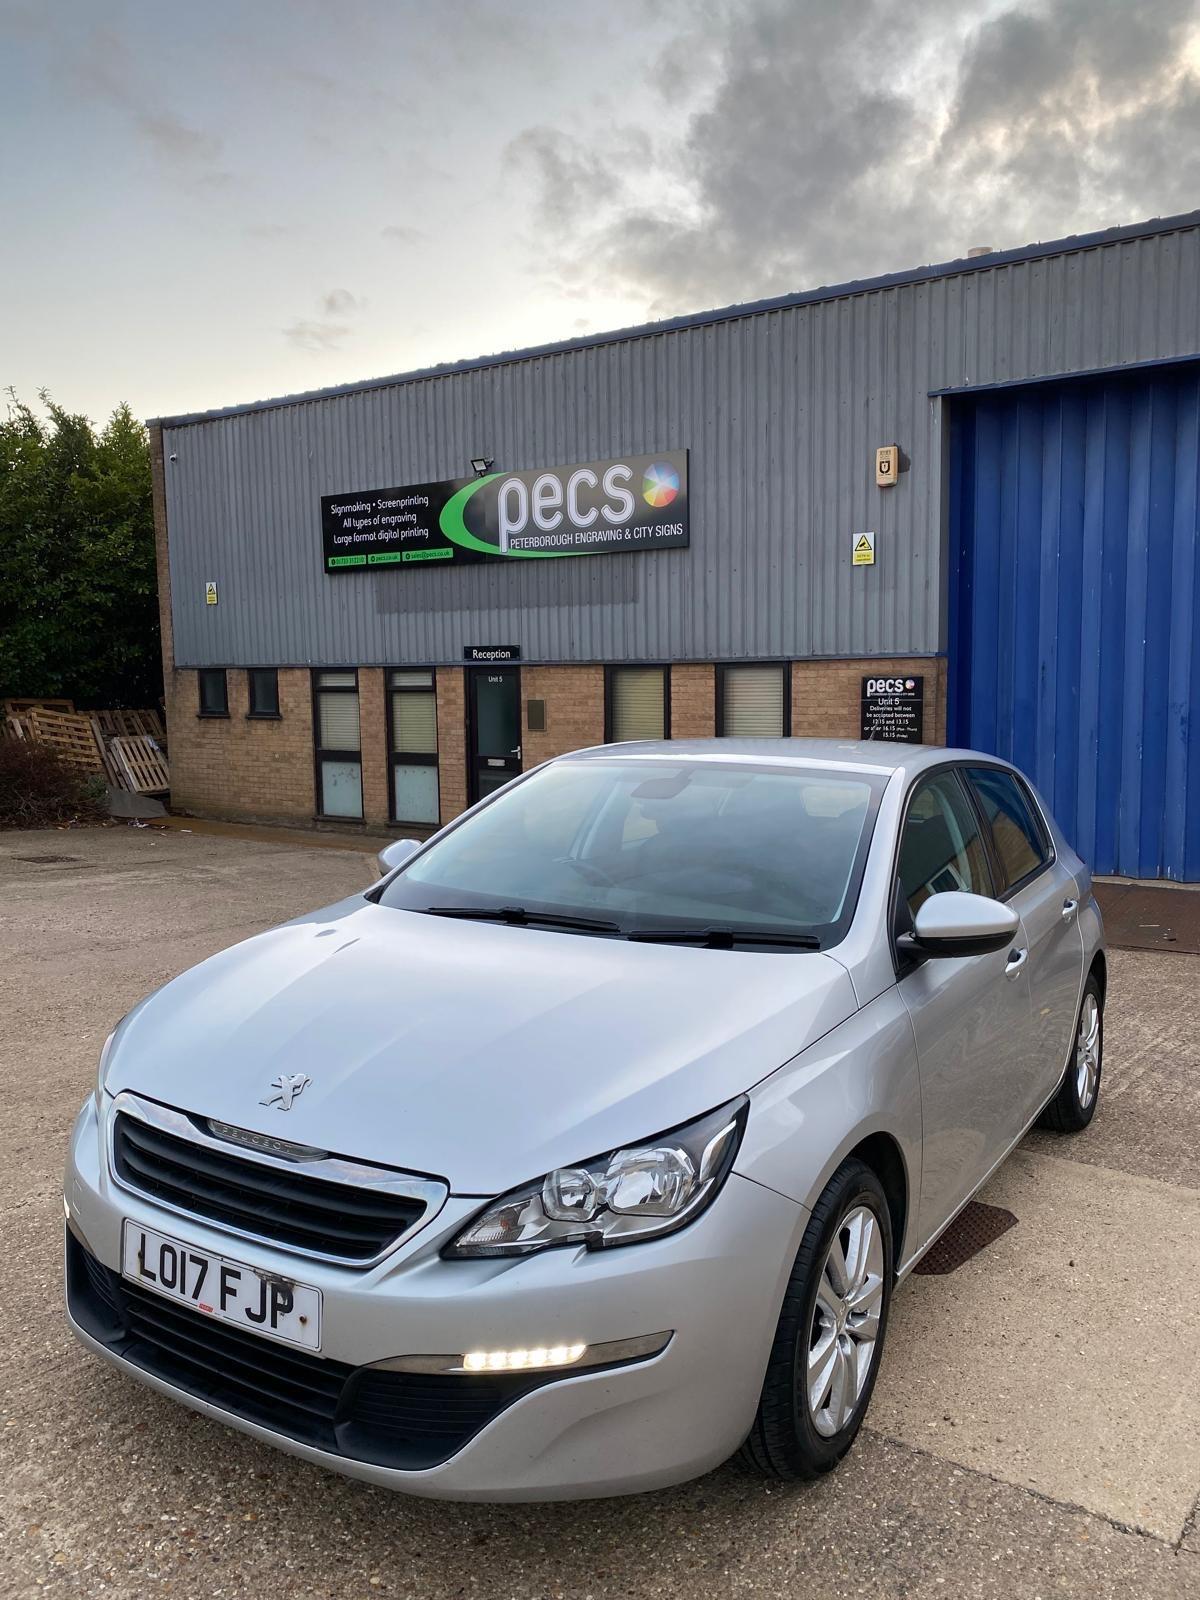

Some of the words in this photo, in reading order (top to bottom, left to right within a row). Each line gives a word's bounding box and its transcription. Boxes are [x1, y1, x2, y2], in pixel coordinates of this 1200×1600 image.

[330, 501, 371, 516] Signmaking
[377, 494, 429, 509] Screenprinting
[498, 464, 635, 553] pecs
[343, 518, 352, 528] All
[352, 517, 372, 529] types
[373, 515, 380, 525] of
[381, 512, 417, 526] engraving
[334, 534, 352, 546] Large
[353, 531, 377, 543] format
[377, 528, 400, 542] digital
[401, 526, 429, 541] printing
[510, 532, 573, 549] PETERBOROUGH
[575, 528, 622, 544] ENGRAVING
[624, 528, 632, 539] &
[633, 526, 653, 539] CITY
[655, 523, 683, 537] SIGNS
[472, 649, 511, 661] Reception
[866, 679, 904, 697] pecs
[894, 697, 900, 705] 5
[222, 1126, 293, 1153] PEUGEOT
[140, 1233, 209, 1300] LO17
[220, 1266, 294, 1329] FJP
